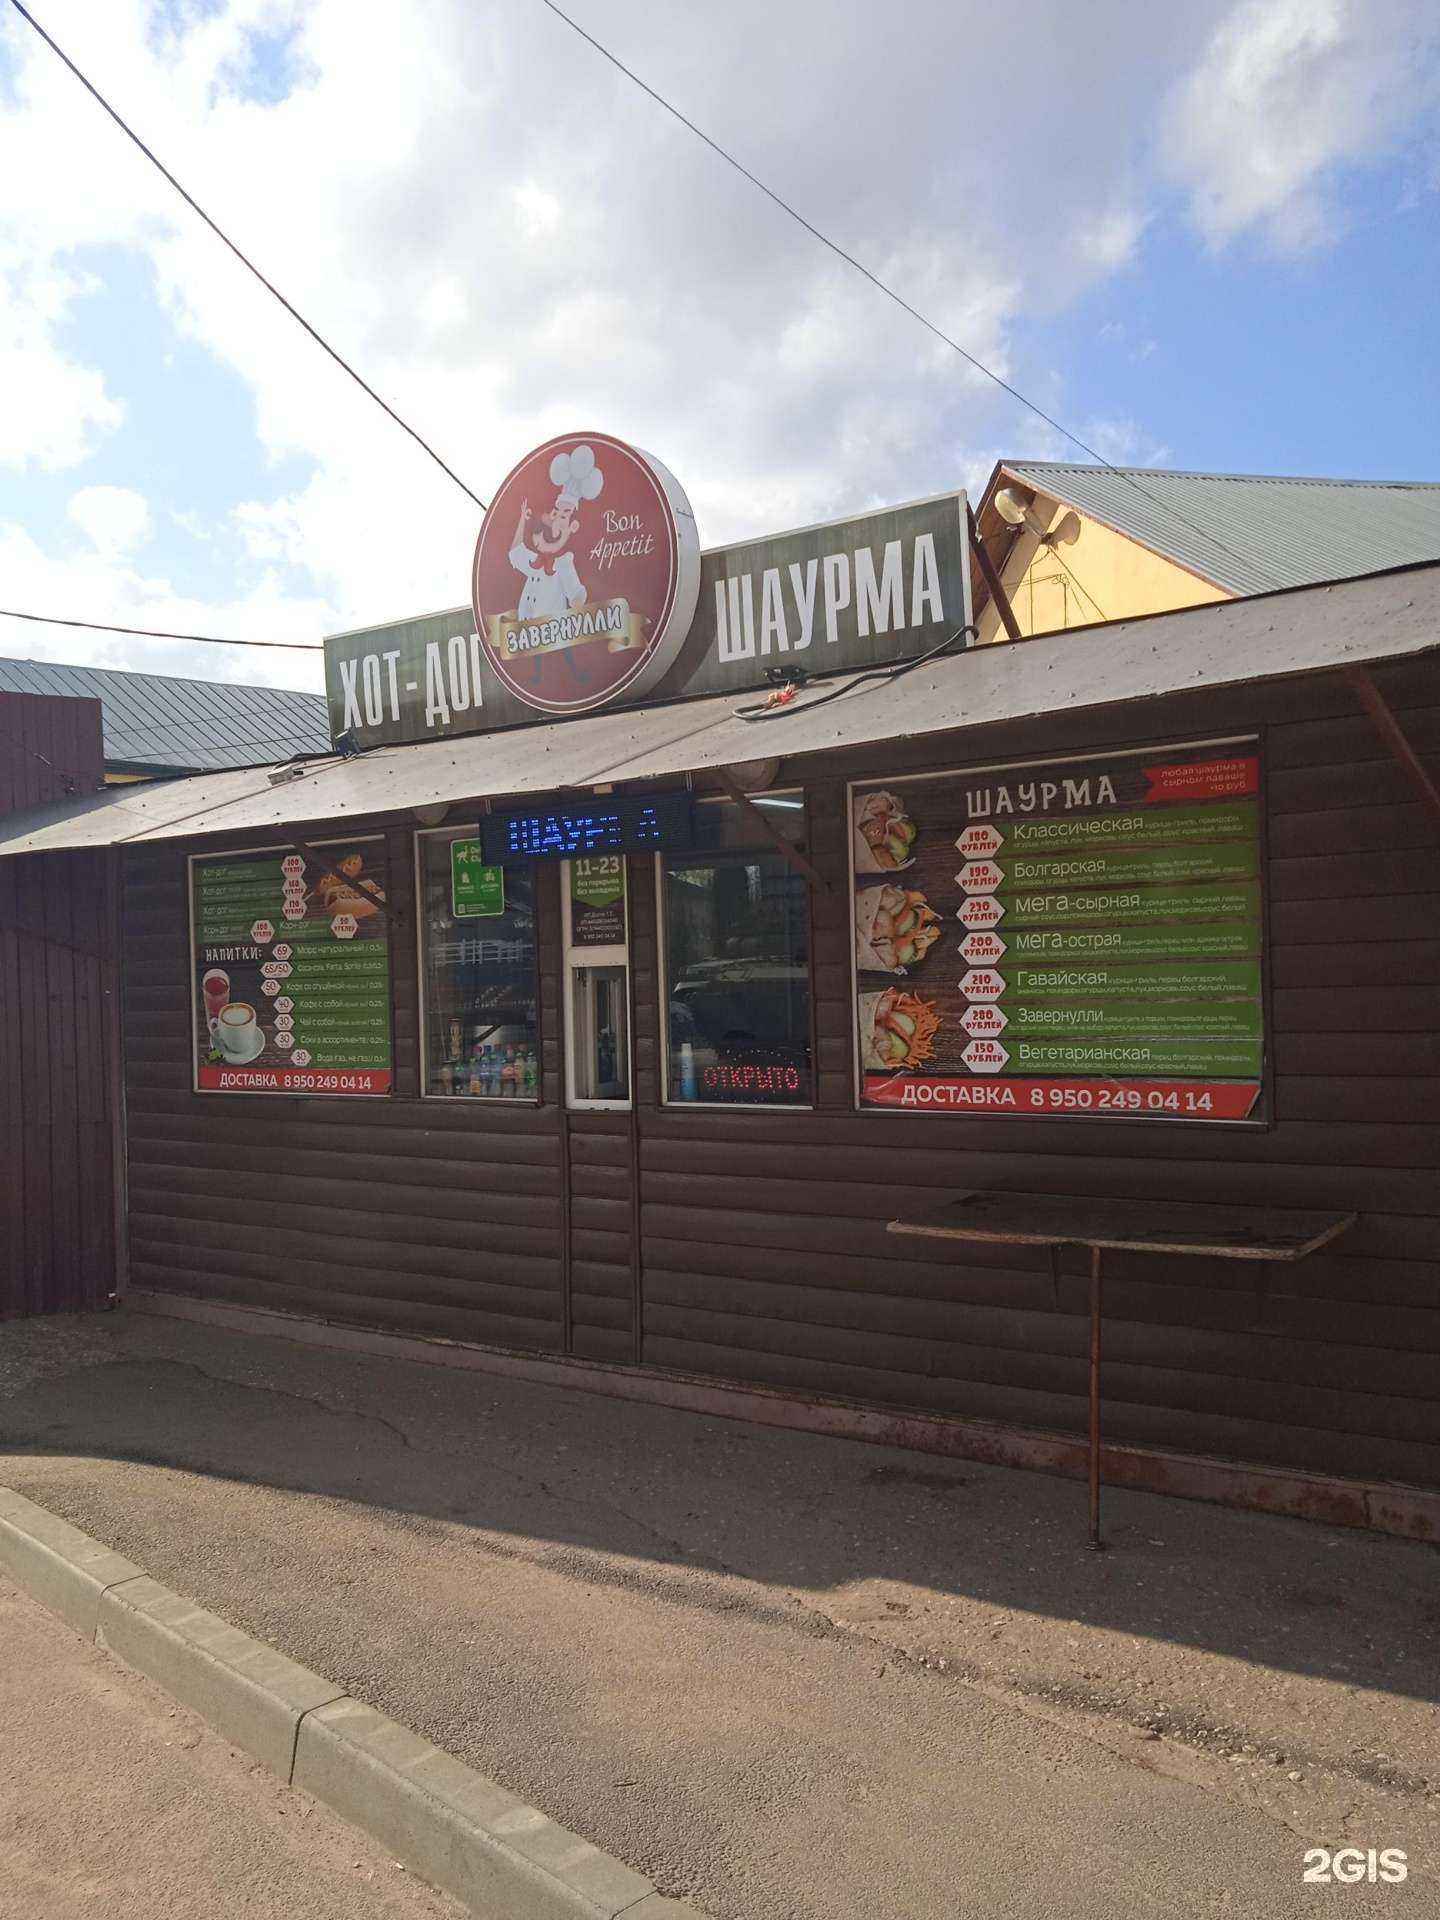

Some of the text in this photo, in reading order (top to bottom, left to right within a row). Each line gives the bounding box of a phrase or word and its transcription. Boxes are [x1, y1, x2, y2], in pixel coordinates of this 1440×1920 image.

[604, 510, 643, 532] Bon
[589, 533, 656, 570] Appetit
[715, 533, 944, 663] ШАУРМА
[507, 605, 623, 653] ЗАВЕРНУЛЛИ
[965, 775, 1116, 818] ШАУРМА
[1014, 817, 1143, 839] Классическая
[961, 840, 998, 851] РУБЛЕЙ
[576, 856, 620, 876] 11-23
[1014, 859, 1105, 878] Болгарская
[962, 875, 998, 886] РУБЛЕЙ
[963, 910, 999, 922] РУБЛЕЙ
[970, 936, 992, 947] 200
[205, 944, 263, 962] НАПИТКИ:
[964, 945, 1000, 956] РУБЛЕЙ
[1017, 970, 1107, 986] Гавайская
[964, 983, 1000, 994] РУБЛЕЙ
[279, 1016, 289, 1026] 30
[1018, 1007, 1103, 1024] Завернулли
[966, 1019, 1002, 1029] РУБЛЕЙ
[279, 1034, 289, 1043] 30
[975, 1042, 994, 1053] 150
[1019, 1044, 1150, 1062] Вегетарианская
[967, 1052, 1003, 1062] РУБЛЕЙ
[219, 1073, 371, 1089] ДОСТАВКА 8 950 249 04 14
[704, 1066, 800, 1088] ОТКРЫТО
[901, 1084, 1213, 1112] ДОСТАВКА 8 950 249 04 14
